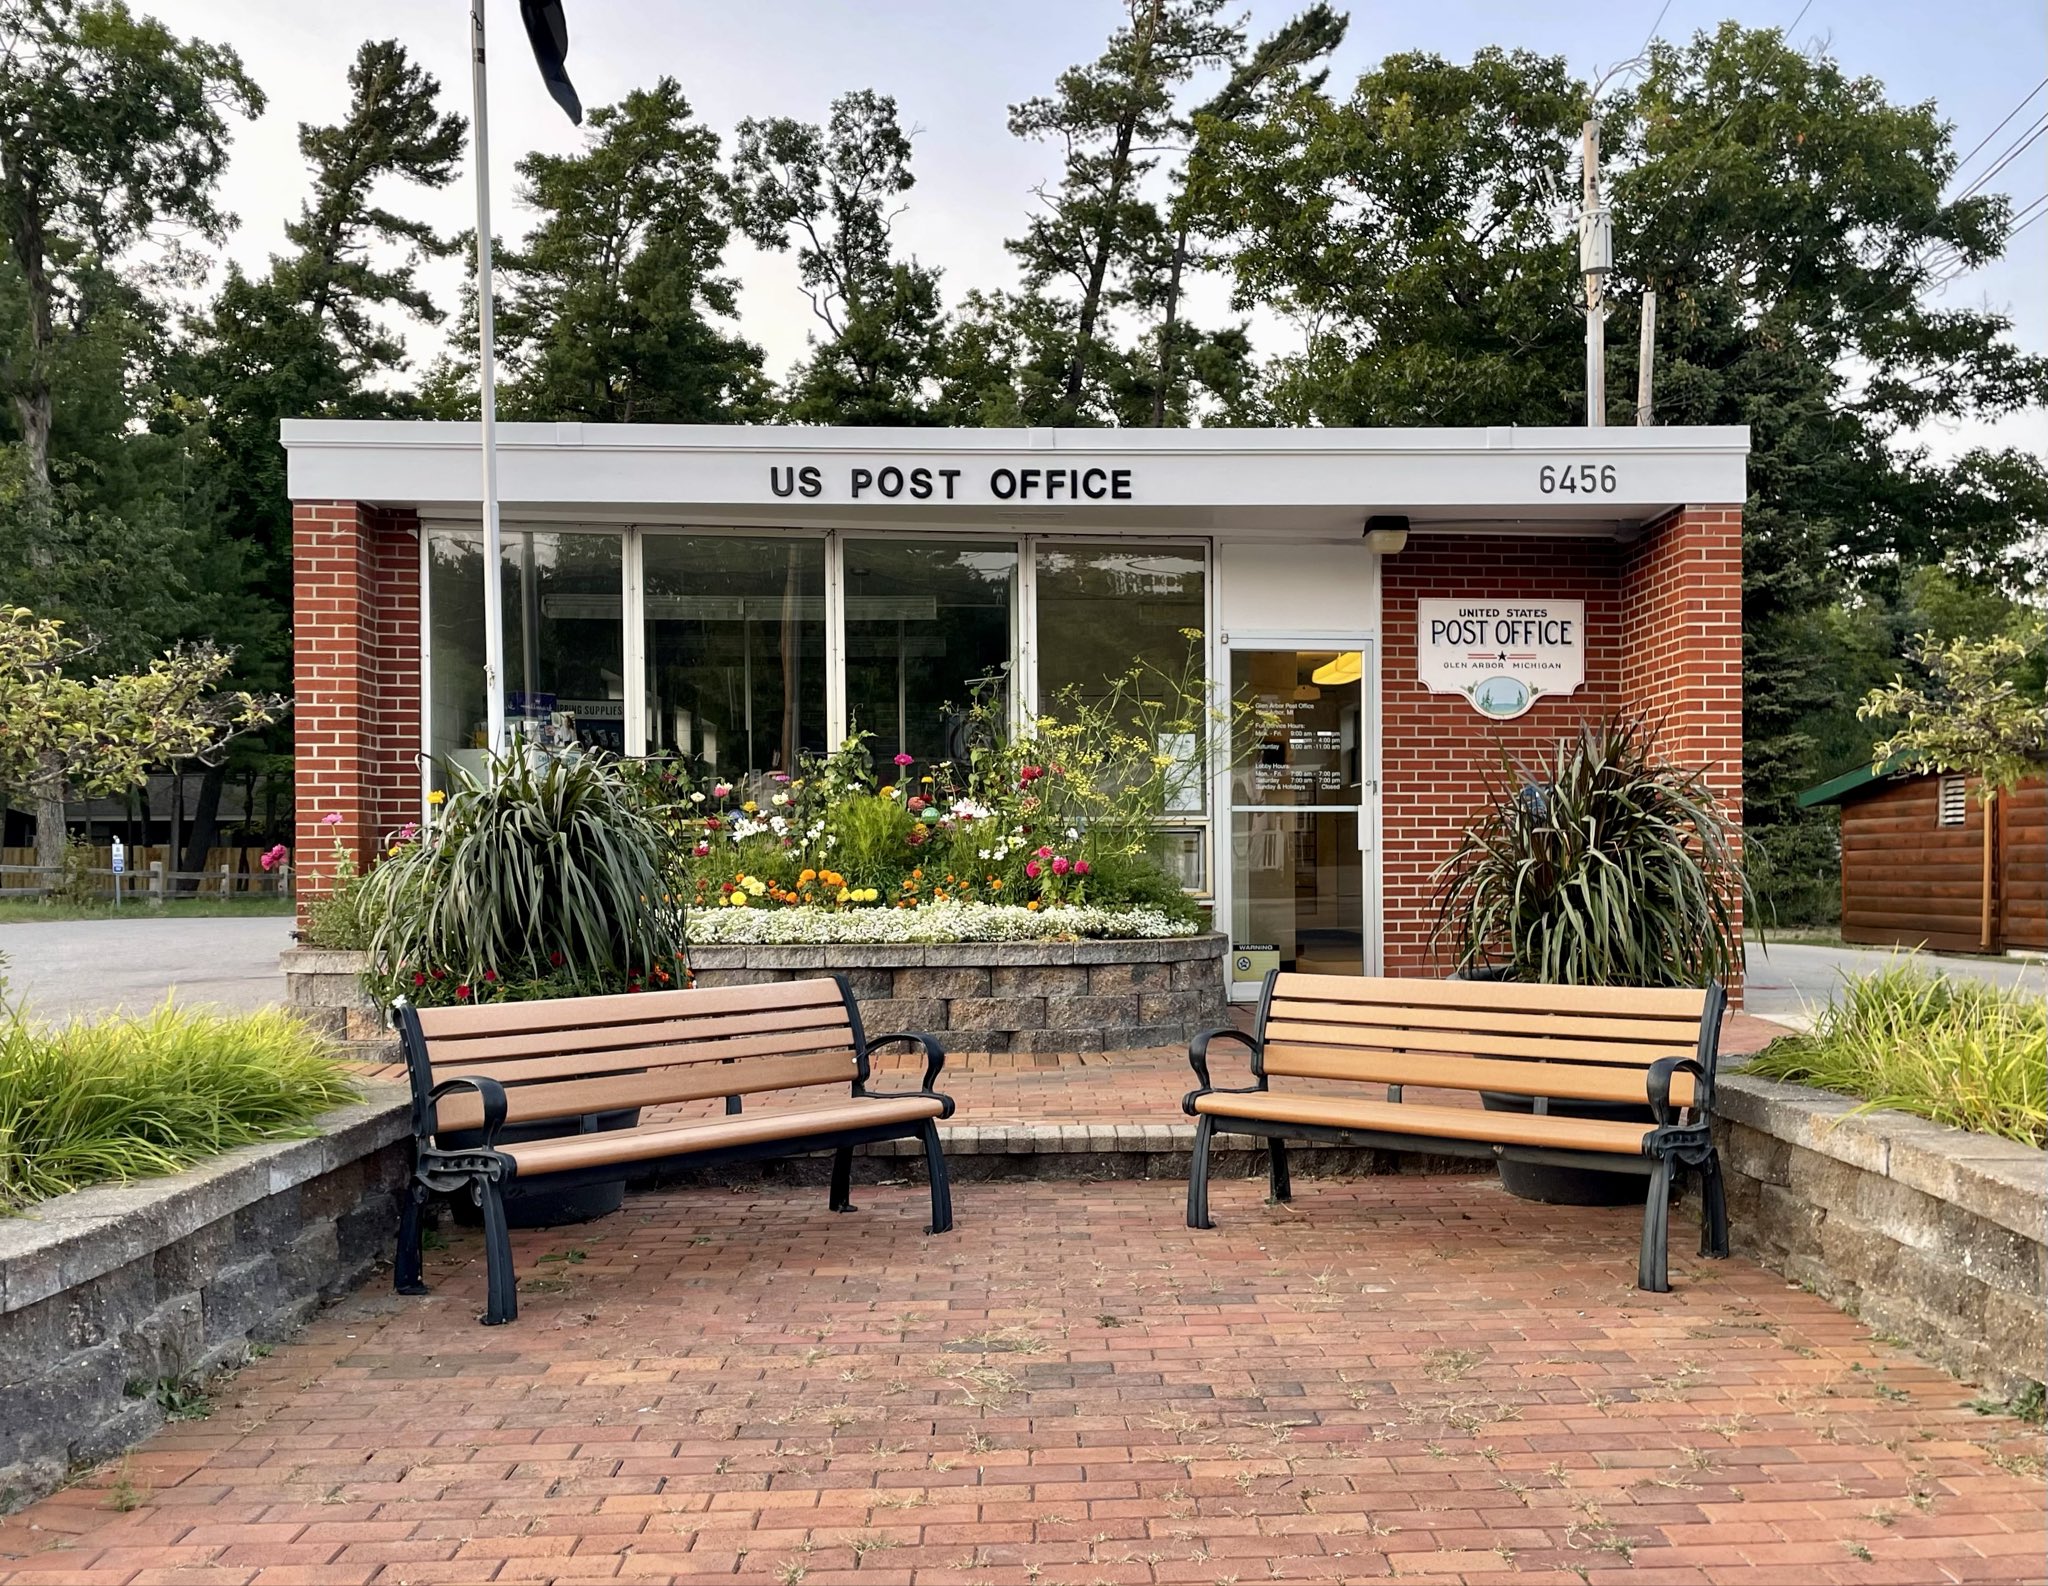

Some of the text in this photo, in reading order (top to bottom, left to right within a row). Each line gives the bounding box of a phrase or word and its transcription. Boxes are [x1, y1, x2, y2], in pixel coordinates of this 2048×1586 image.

[770, 466, 1132, 500] US POST OFFICE
[1539, 464, 1617, 494] 6456
[1459, 608, 1548, 618] UNITED STATES
[1431, 619, 1573, 646] POST OFFICE
[557, 704, 623, 716] IPPING SUPPLIES
